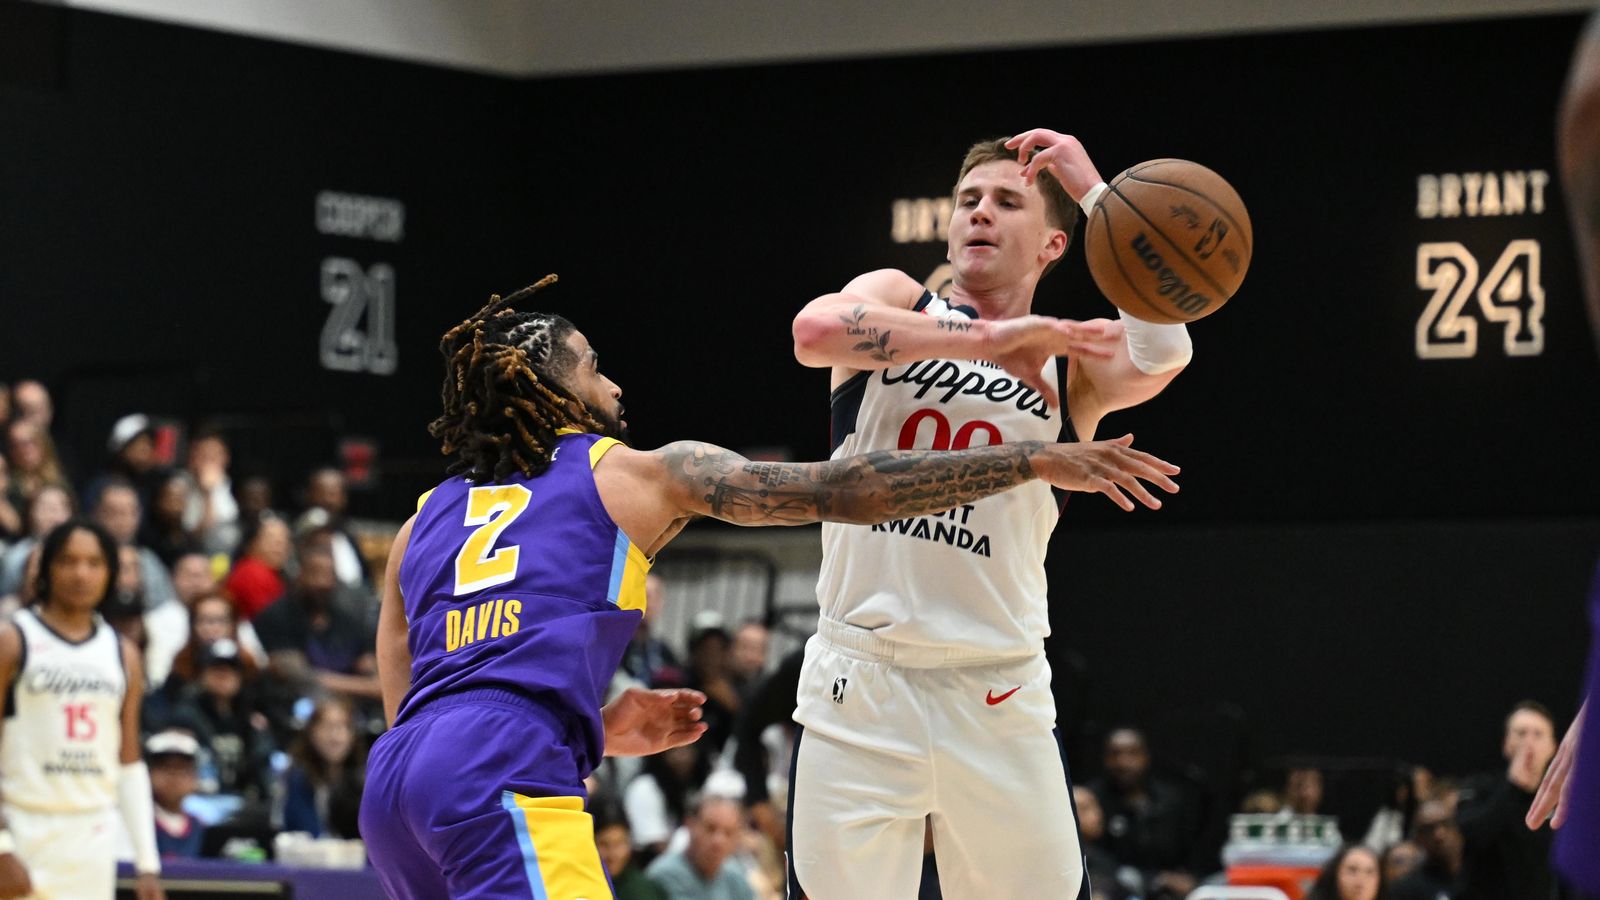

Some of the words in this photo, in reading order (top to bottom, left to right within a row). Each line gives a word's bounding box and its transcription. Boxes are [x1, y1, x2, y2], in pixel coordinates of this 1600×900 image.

[1416, 169, 1549, 219] BRYANT
[891, 197, 954, 243] BRY
[319, 256, 398, 376] 21
[1415, 239, 1546, 360] 24
[846, 327, 866, 336] Luke
[868, 327, 878, 336] 15
[937, 319, 973, 332] STAY
[454, 483, 532, 597] 2
[445, 599, 522, 653] DAVIS
[63, 703, 97, 742] 15
